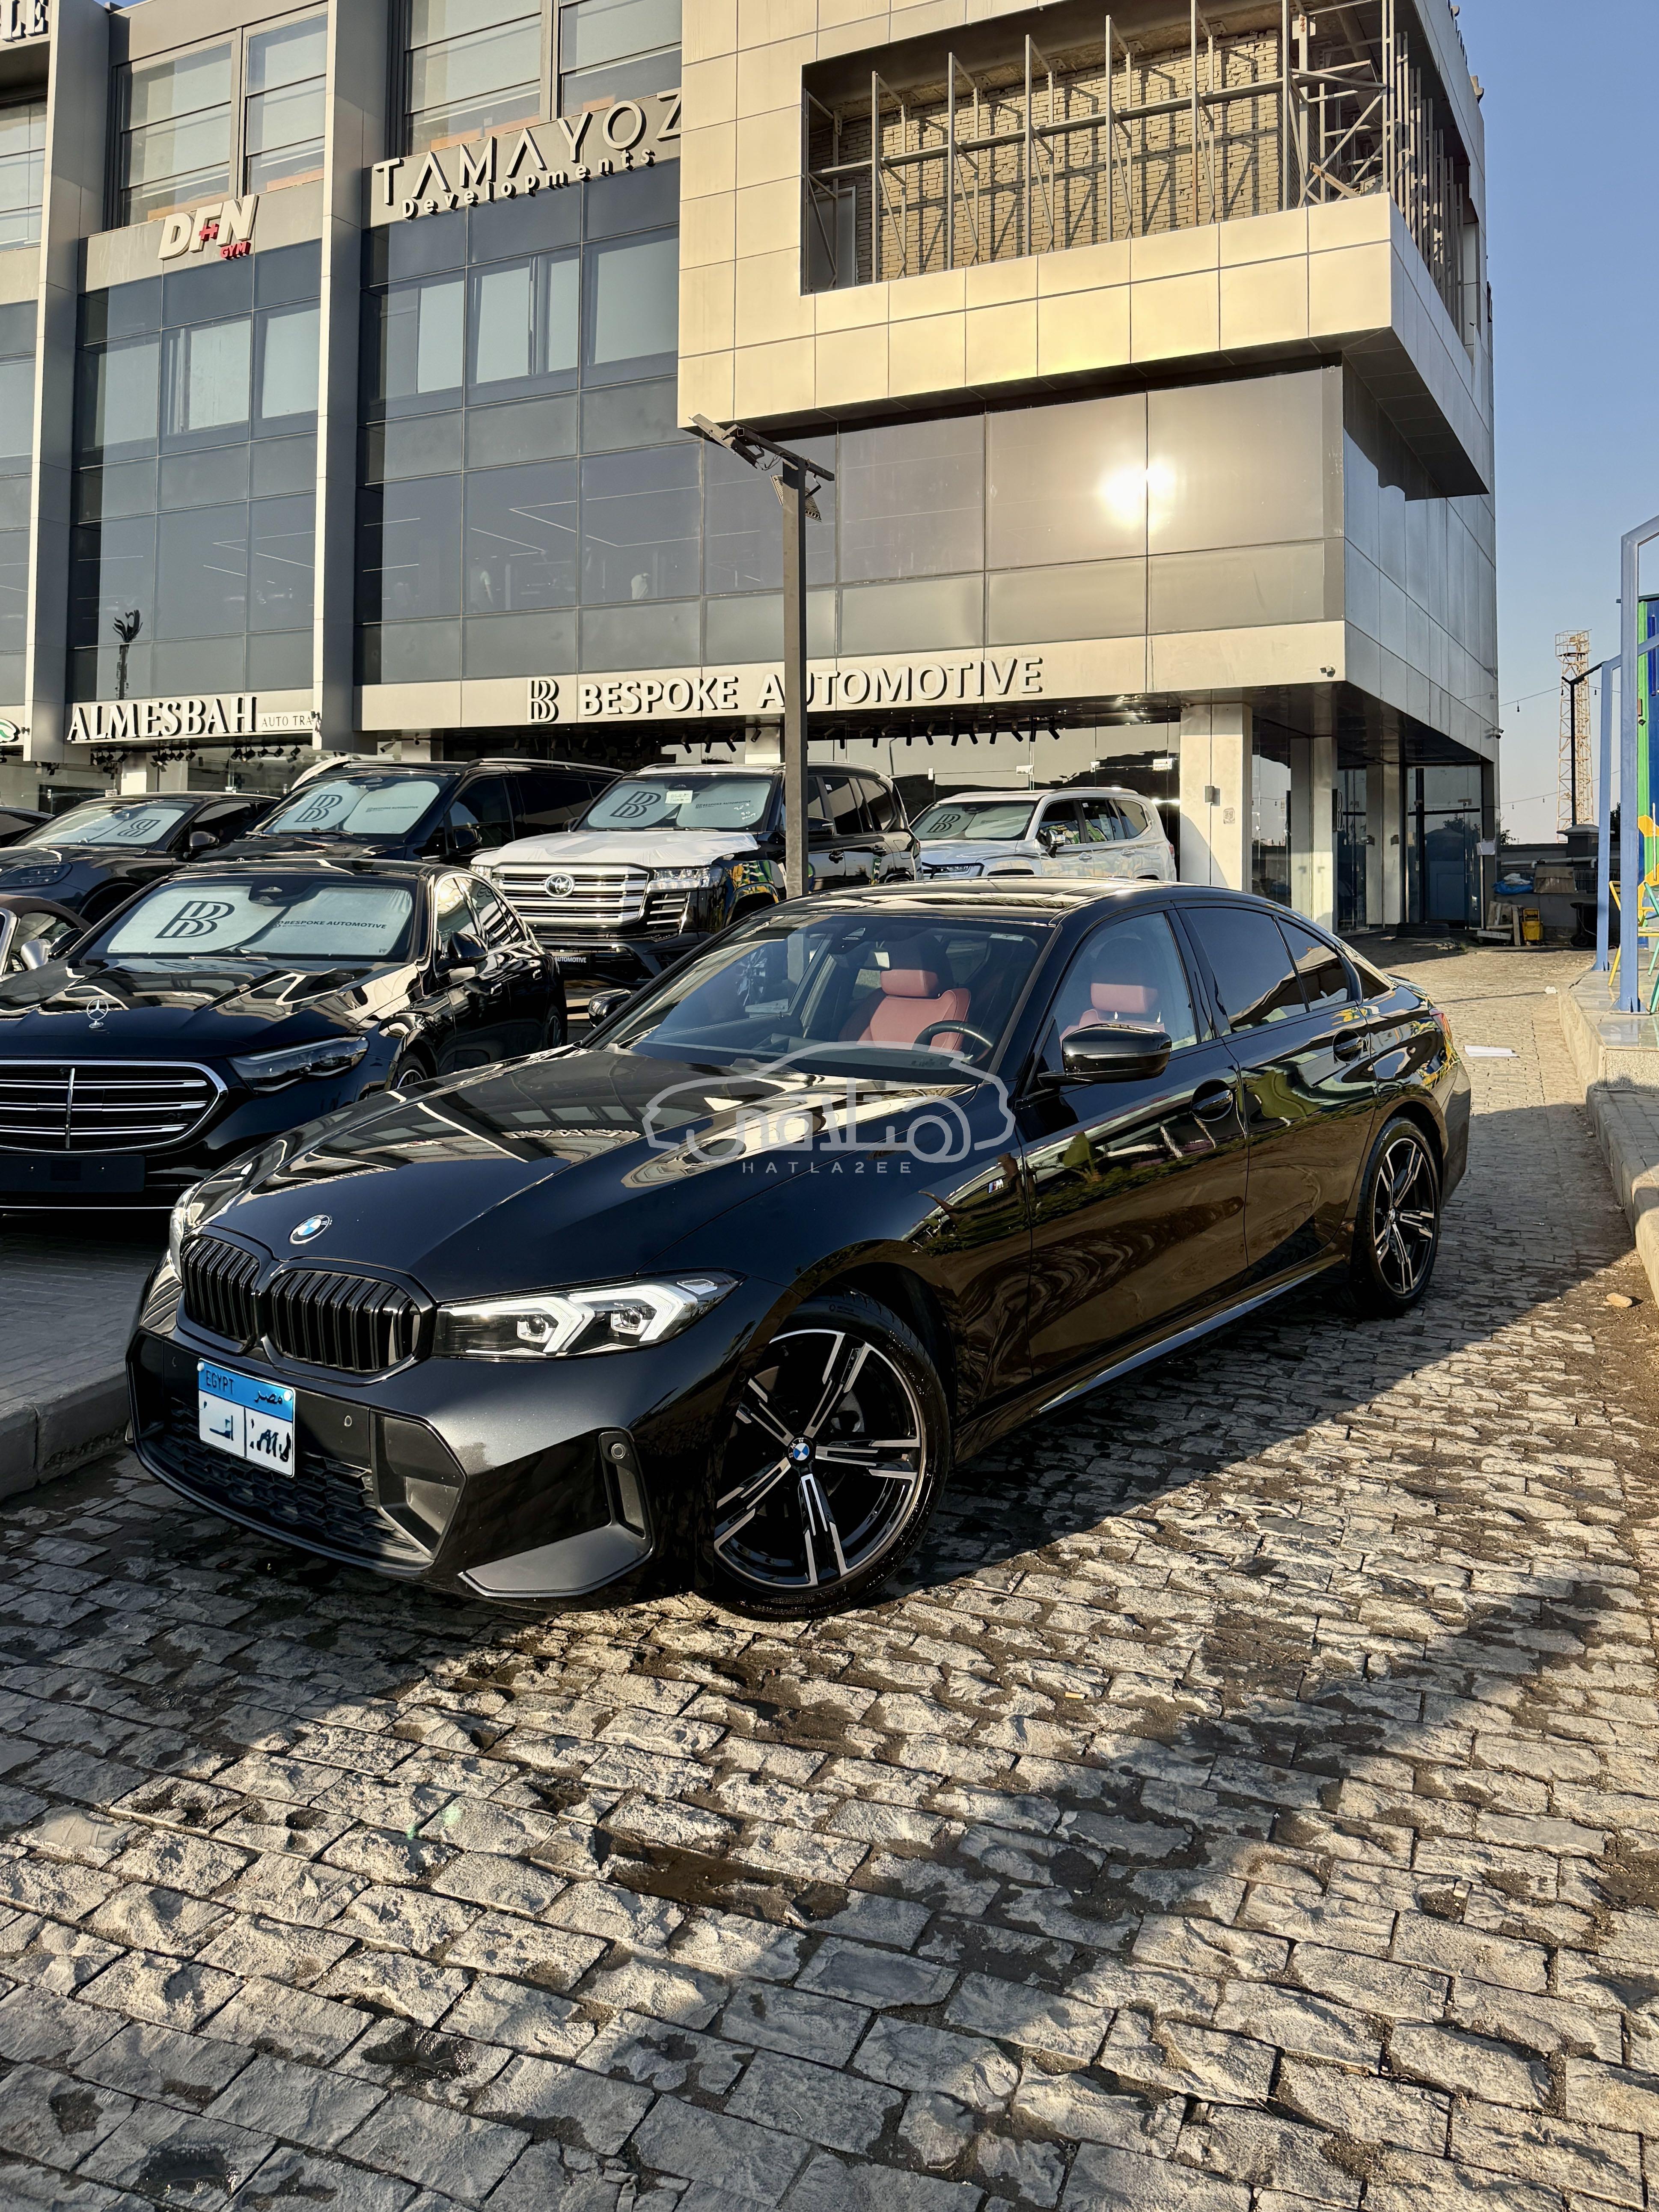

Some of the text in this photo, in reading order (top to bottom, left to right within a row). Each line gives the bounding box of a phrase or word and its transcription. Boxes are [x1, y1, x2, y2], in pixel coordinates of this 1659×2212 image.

[402, 147, 655, 220] Developments
[220, 241, 251, 259] GYM
[579, 676, 739, 716] BESPOKE
[756, 656, 1043, 709] ATOMOTIVE
[67, 696, 257, 741] ALMESBAH
[262, 716, 288, 727] AUTO
[327, 921, 387, 929] AUTOMOTIVE
[205, 1370, 234, 1394] EGYPT
[254, 1391, 283, 1405] مصر
